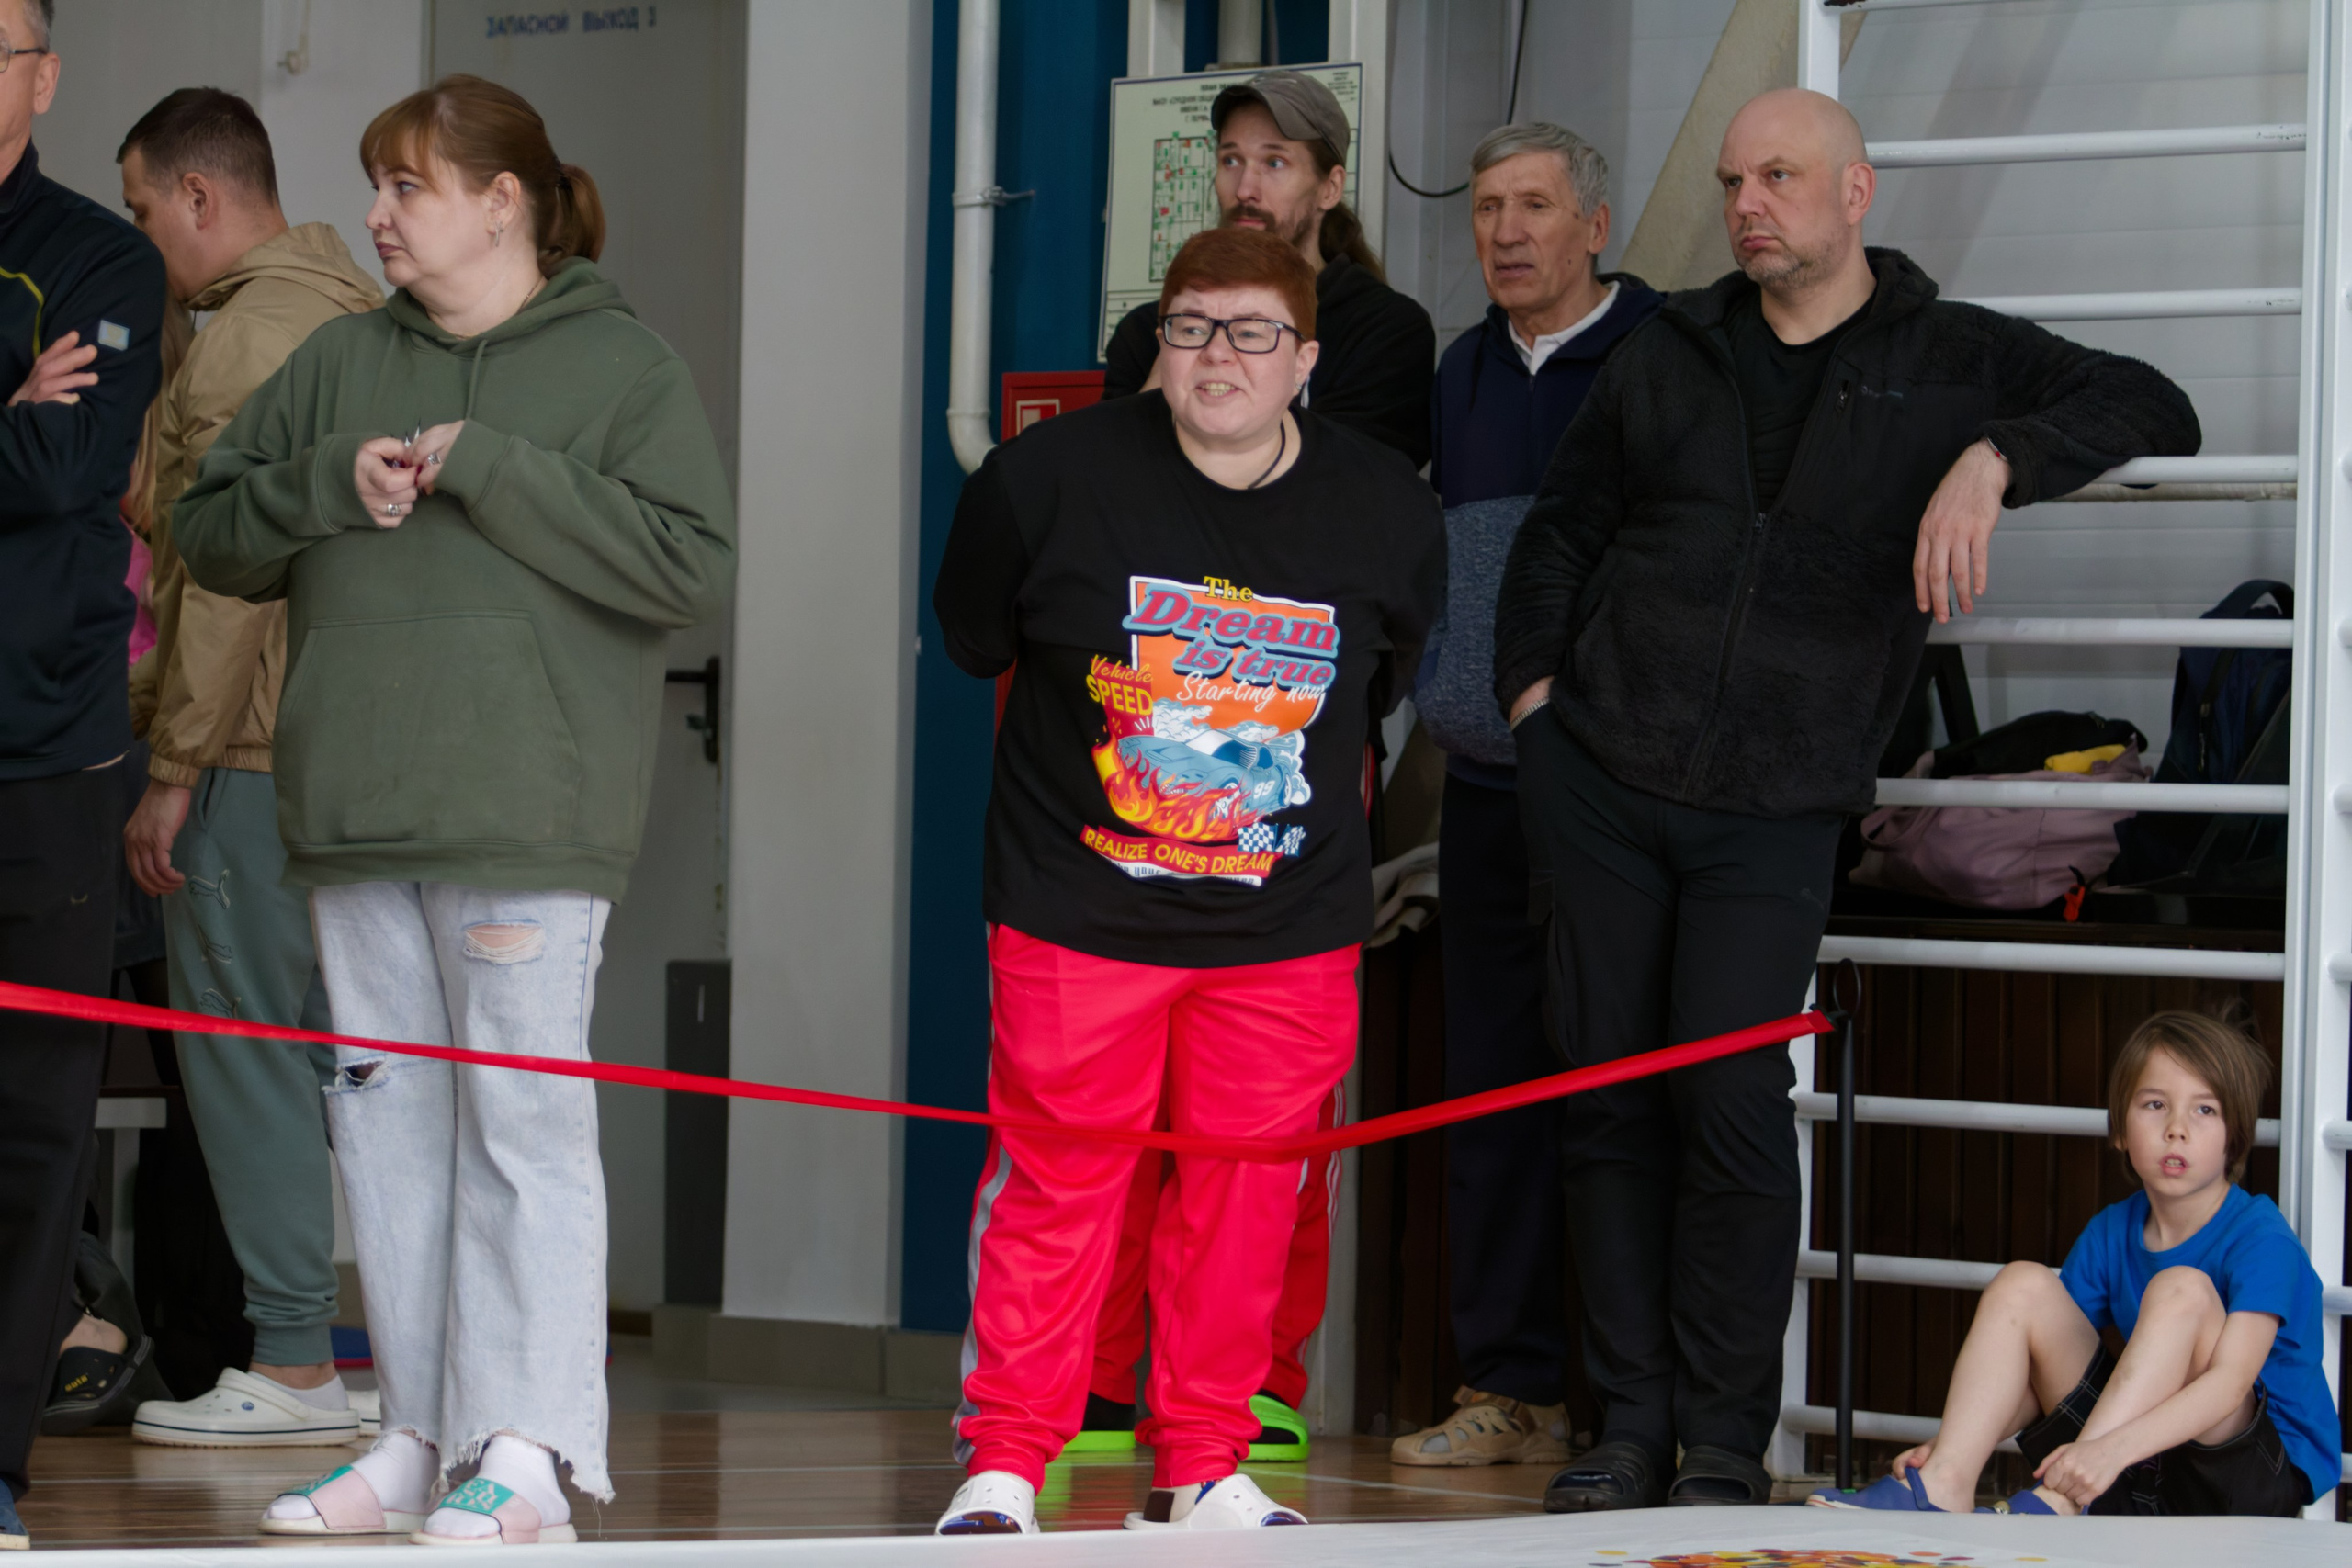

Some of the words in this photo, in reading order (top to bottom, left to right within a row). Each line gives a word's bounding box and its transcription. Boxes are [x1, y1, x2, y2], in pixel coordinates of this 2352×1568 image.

[486, 9, 570, 38] ЗАПАСНОЙ
[582, 6, 639, 33] ВЫХОД
[1204, 576, 1253, 602] The
[1127, 587, 1338, 653] Dream
[1091, 653, 1153, 683] Vehicle
[1175, 638, 1229, 671] is
[1235, 647, 1333, 687] true
[1086, 674, 1152, 716] SPEED
[1177, 671, 1277, 713] Starting
[1285, 683, 1327, 703] now
[1252, 780, 1276, 800] 99
[1085, 829, 1148, 861] REALIZE
[1154, 843, 1209, 874] ONE'S
[1210, 853, 1275, 874] DREAM
